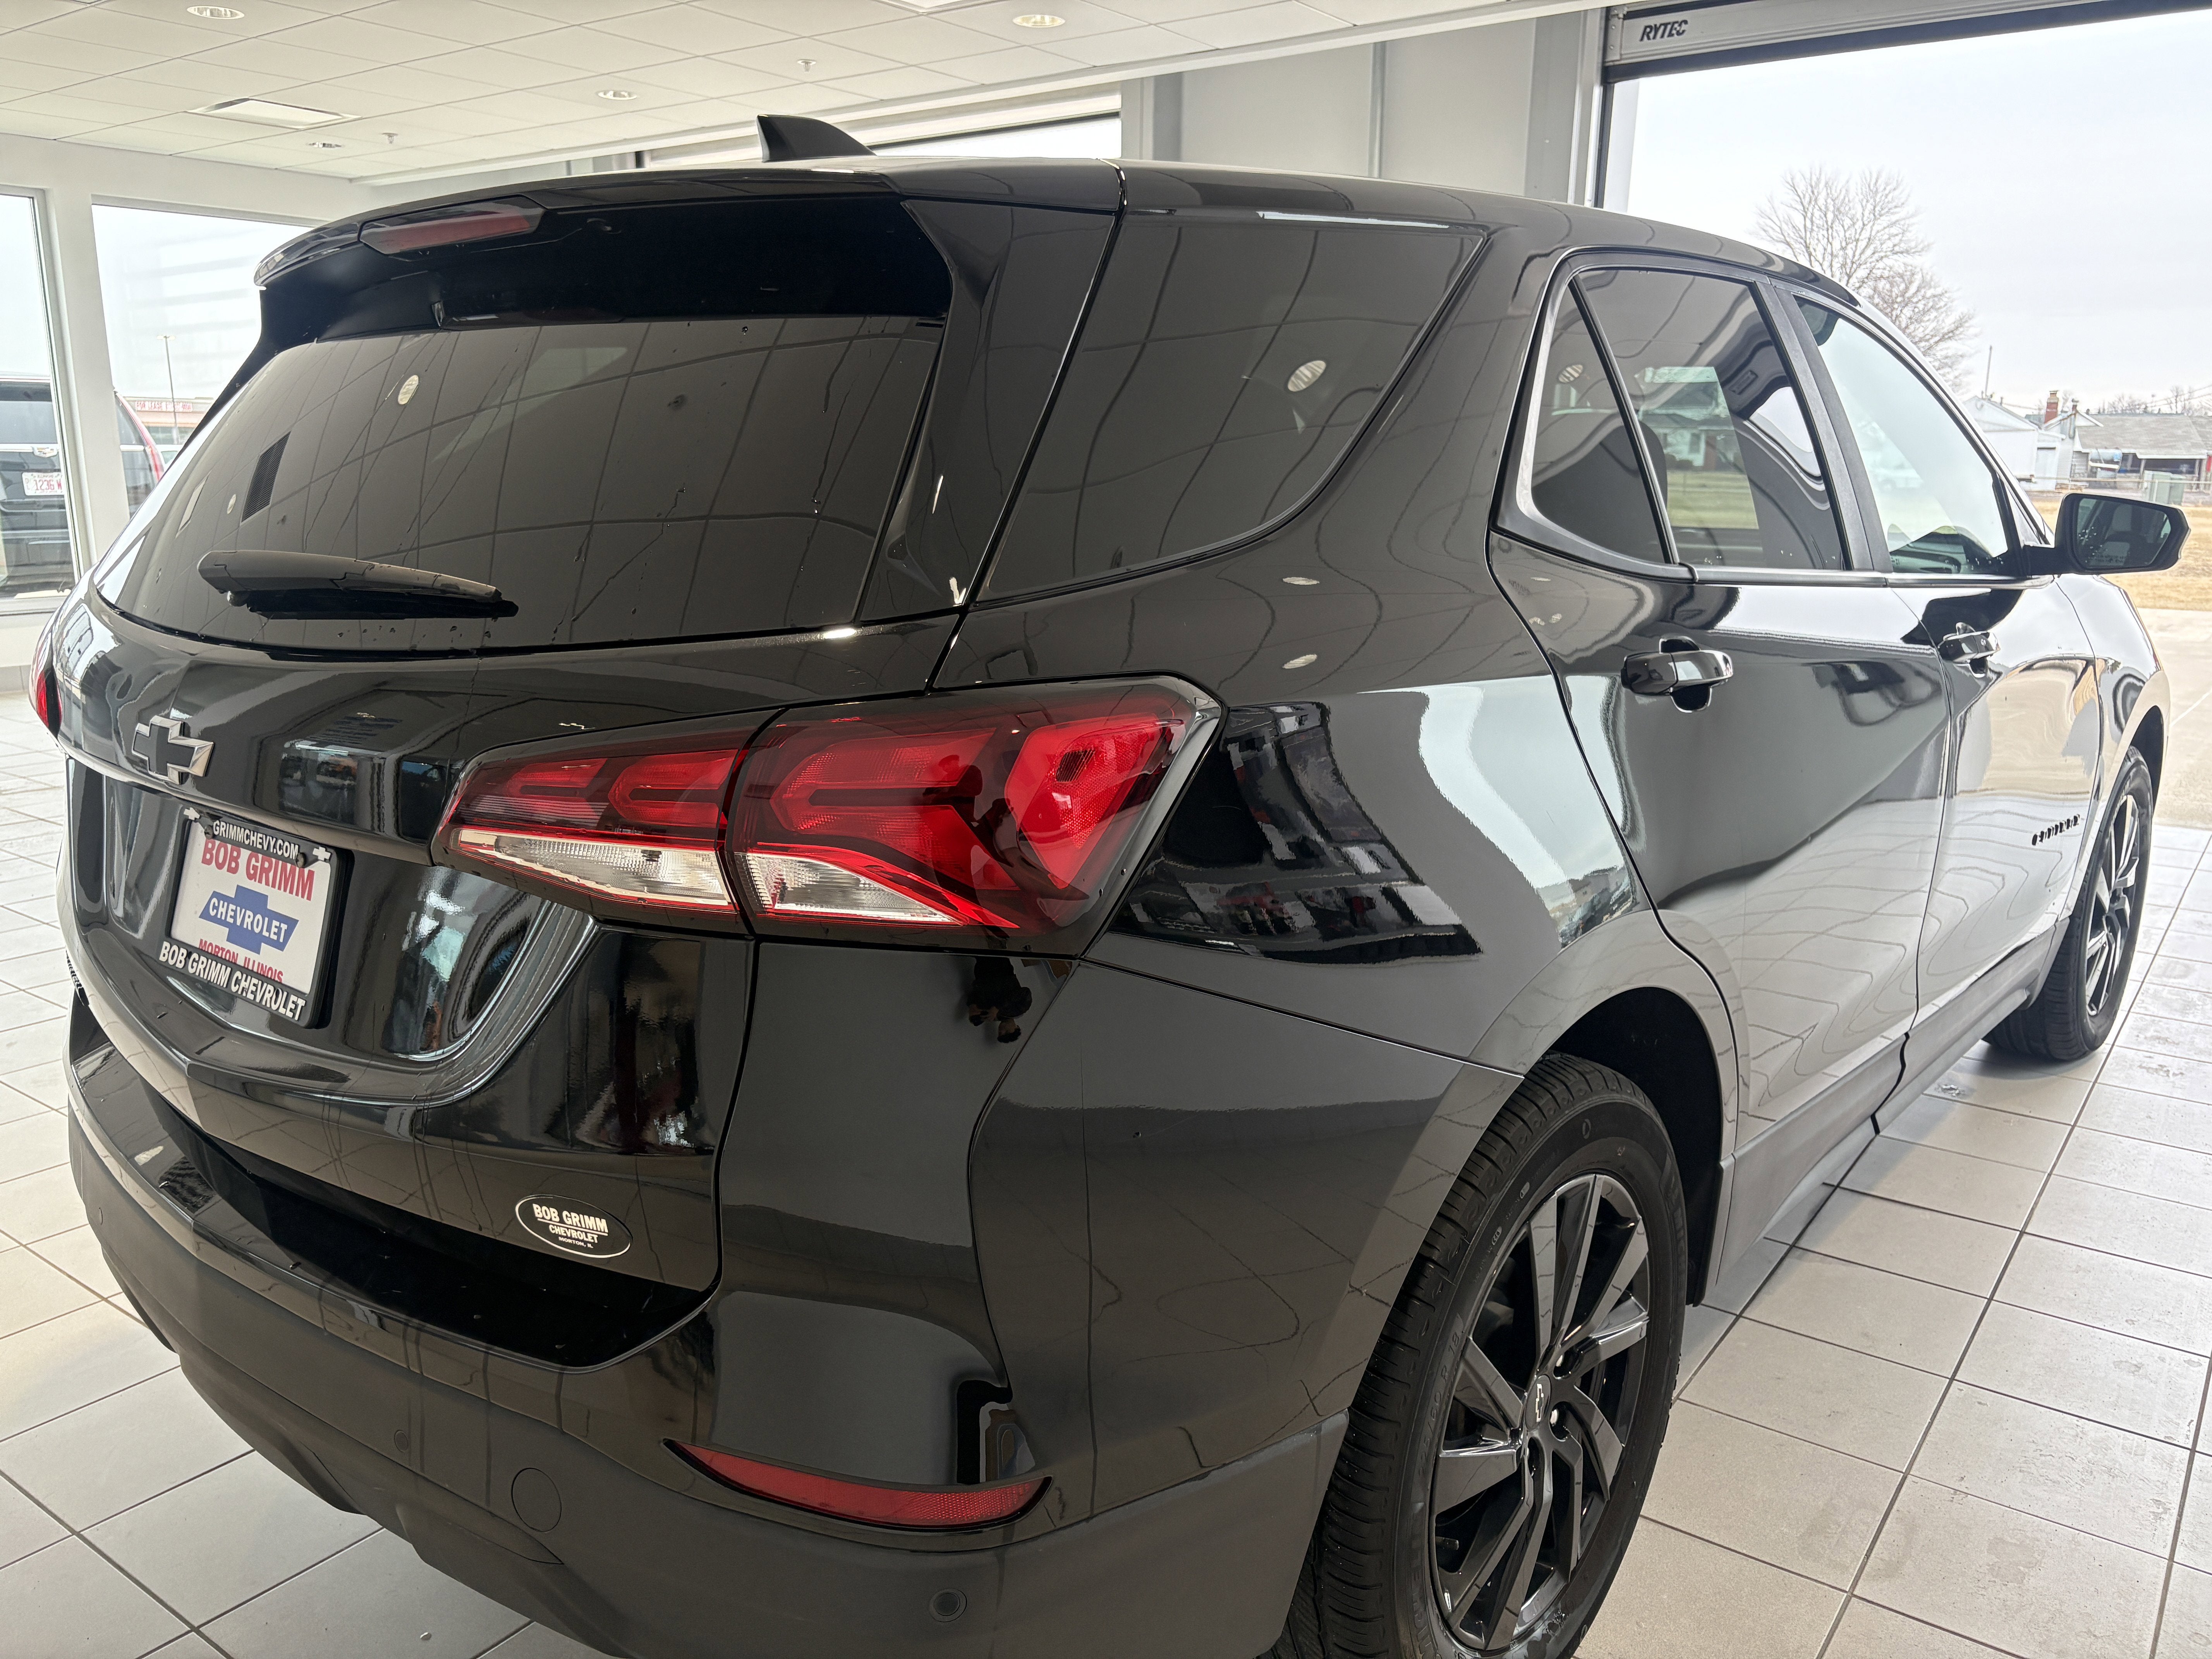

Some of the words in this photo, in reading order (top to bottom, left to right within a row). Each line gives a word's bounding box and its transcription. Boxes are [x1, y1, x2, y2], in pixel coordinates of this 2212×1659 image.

[1639, 19, 1688, 42] RYTEC
[213, 820, 299, 860] GRIMMCHEVY.COM
[201, 839, 241, 874] BOB
[246, 852, 315, 901] GRIMM
[209, 898, 287, 943] CHEVROLET
[159, 941, 187, 969] BOB
[188, 953, 232, 988] GRIMM
[231, 970, 305, 1021] CHEVROLET
[199, 939, 239, 964] MORTON
[244, 957, 283, 984] ILLINOIS
[532, 1203, 560, 1222] BOB
[562, 1211, 608, 1233] GRIMM
[549, 1224, 598, 1243] CHEVROLET
[559, 1237, 586, 1248] MORTON,
